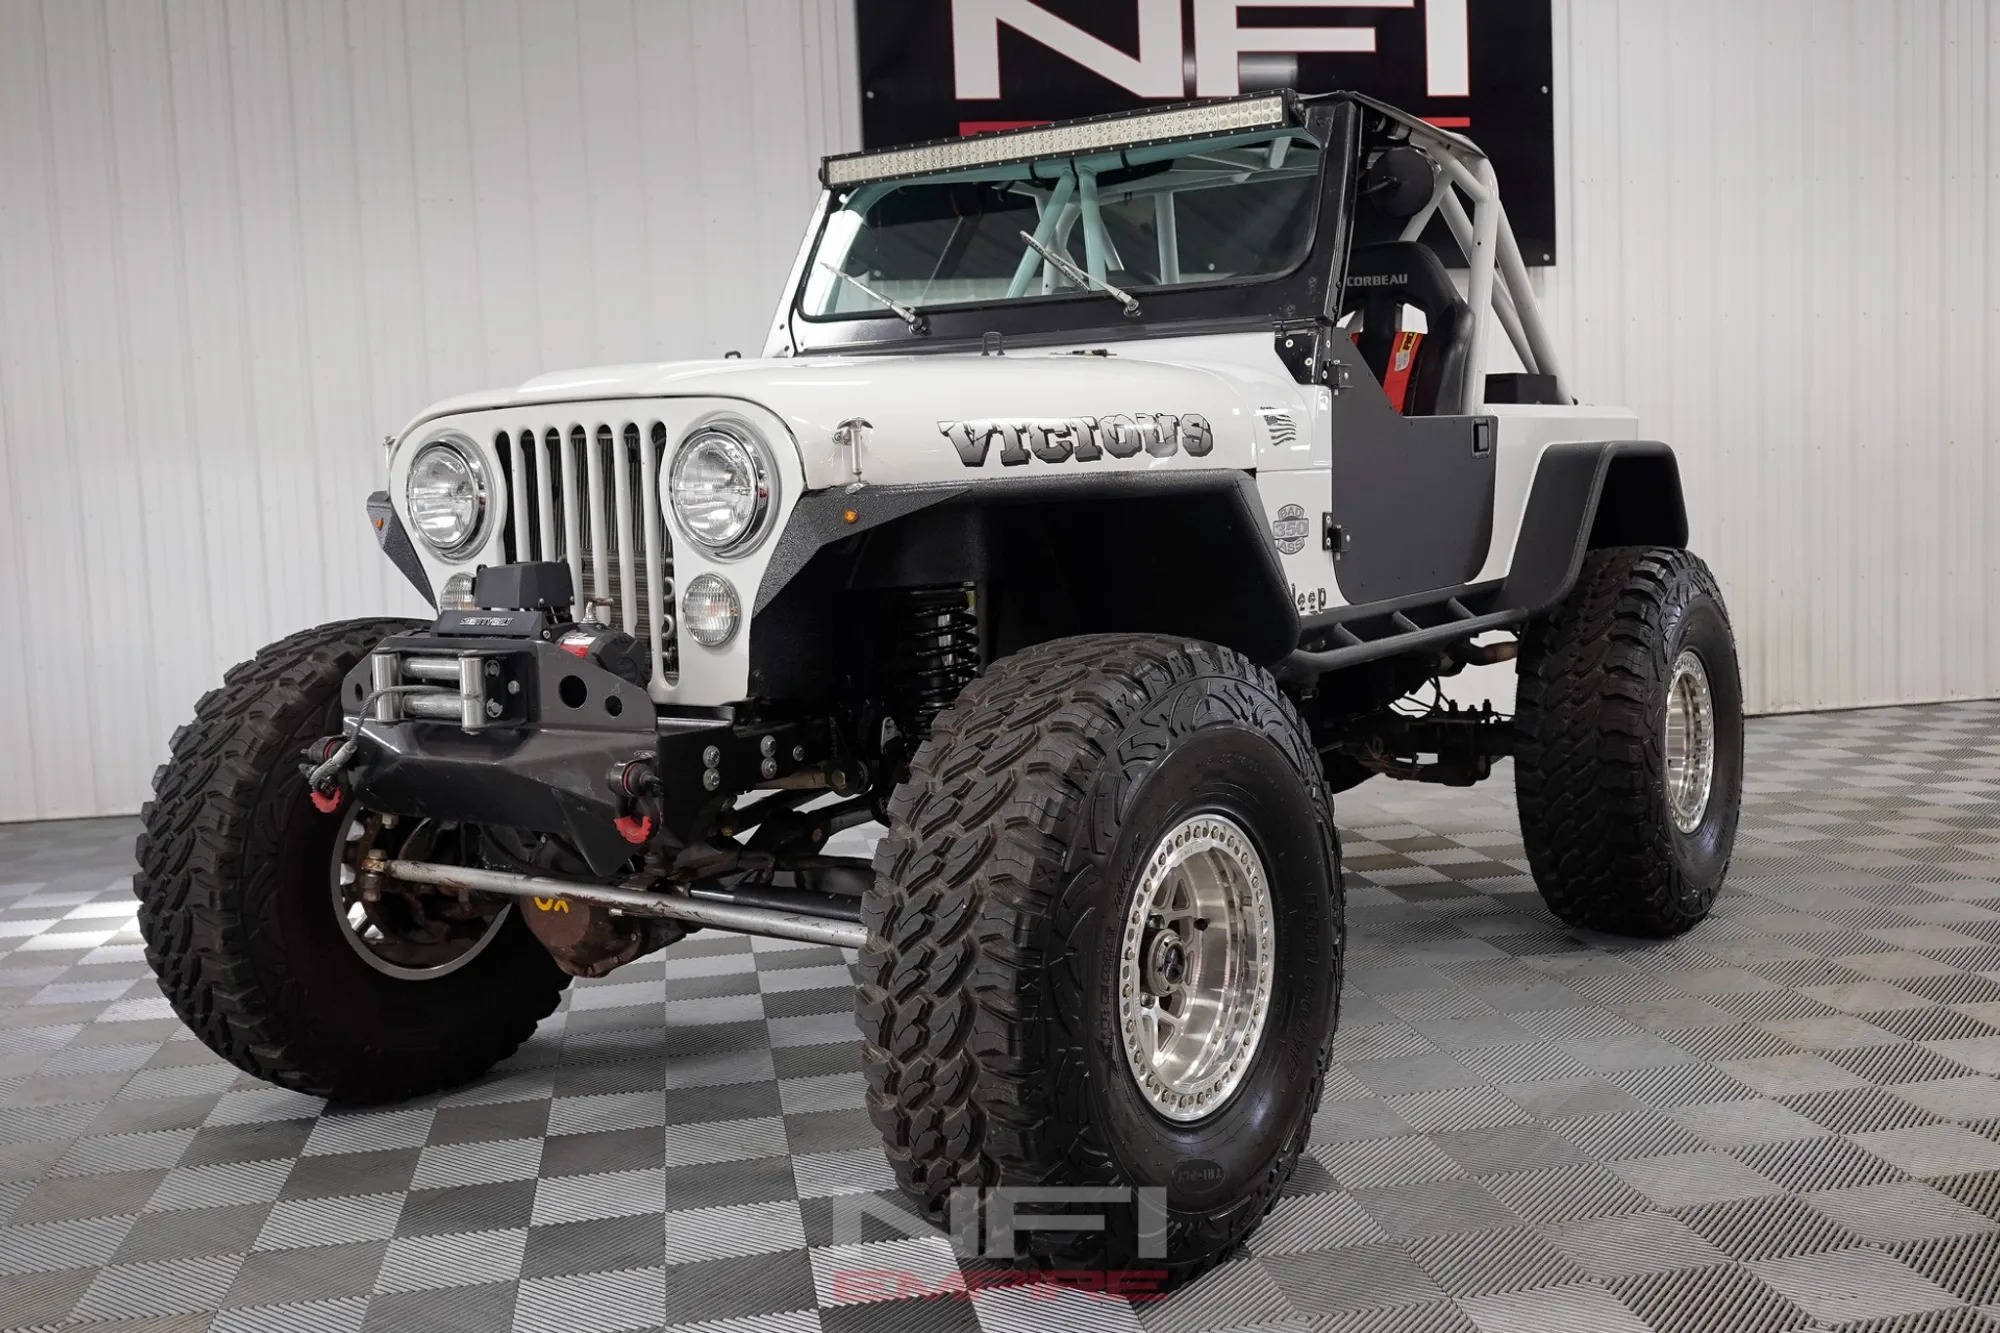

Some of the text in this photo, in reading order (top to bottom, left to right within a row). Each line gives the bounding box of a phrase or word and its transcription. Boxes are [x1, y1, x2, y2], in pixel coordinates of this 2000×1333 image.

[953, 0, 1470, 99] NFI
[1346, 273, 1408, 287] CORBEAU
[936, 413, 1214, 467] VICIOUS
[1280, 506, 1303, 519] BAD
[1275, 521, 1307, 538] 350
[1279, 538, 1303, 553] ASS
